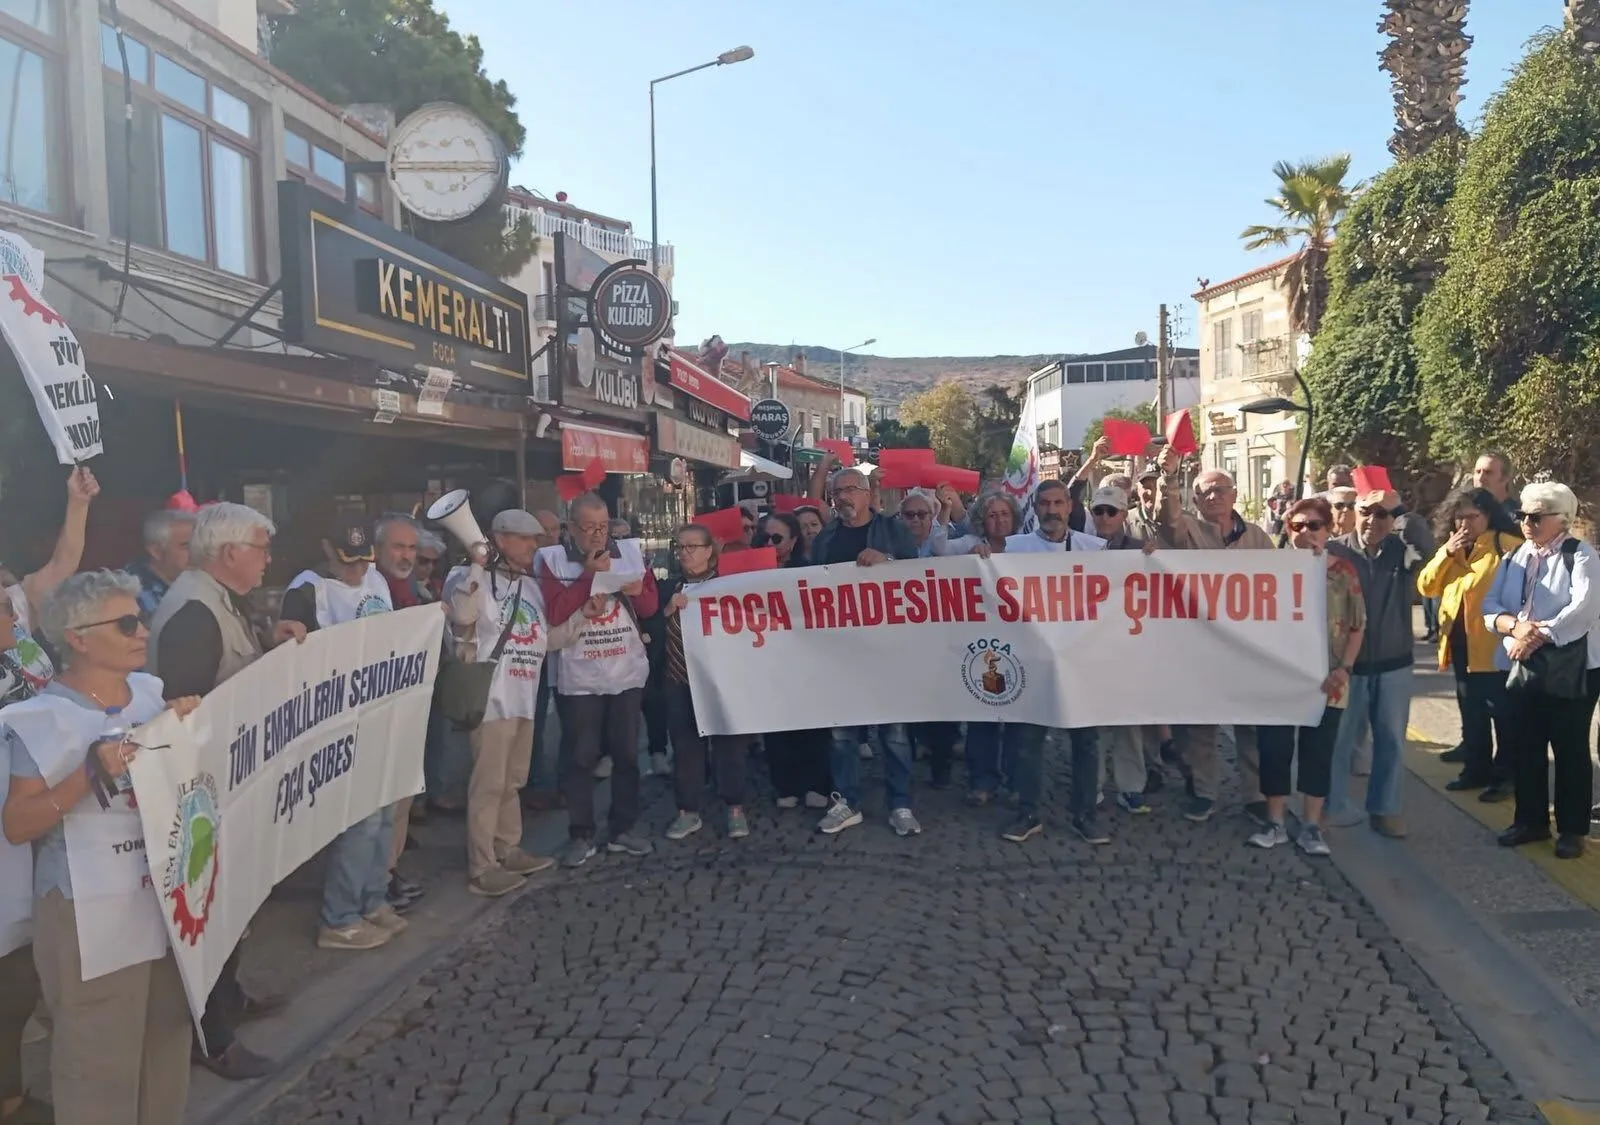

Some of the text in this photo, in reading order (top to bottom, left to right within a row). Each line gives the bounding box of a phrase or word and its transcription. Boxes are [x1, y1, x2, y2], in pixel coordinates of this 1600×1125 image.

[378, 258, 511, 354] KEMERALTI
[613, 280, 649, 304] PİZZA
[608, 303, 653, 327] KULÜBÜ
[595, 367, 638, 409] KULÜBÜ
[752, 413, 788, 424] MARAŞ
[698, 591, 792, 648] FOÇA
[798, 569, 986, 629] İRADESİNE
[996, 565, 1110, 622] SAHİP
[1124, 572, 1277, 635] ÇIKIYOR
[967, 638, 1011, 655] FOÇA
[229, 723, 257, 792] TÜM
